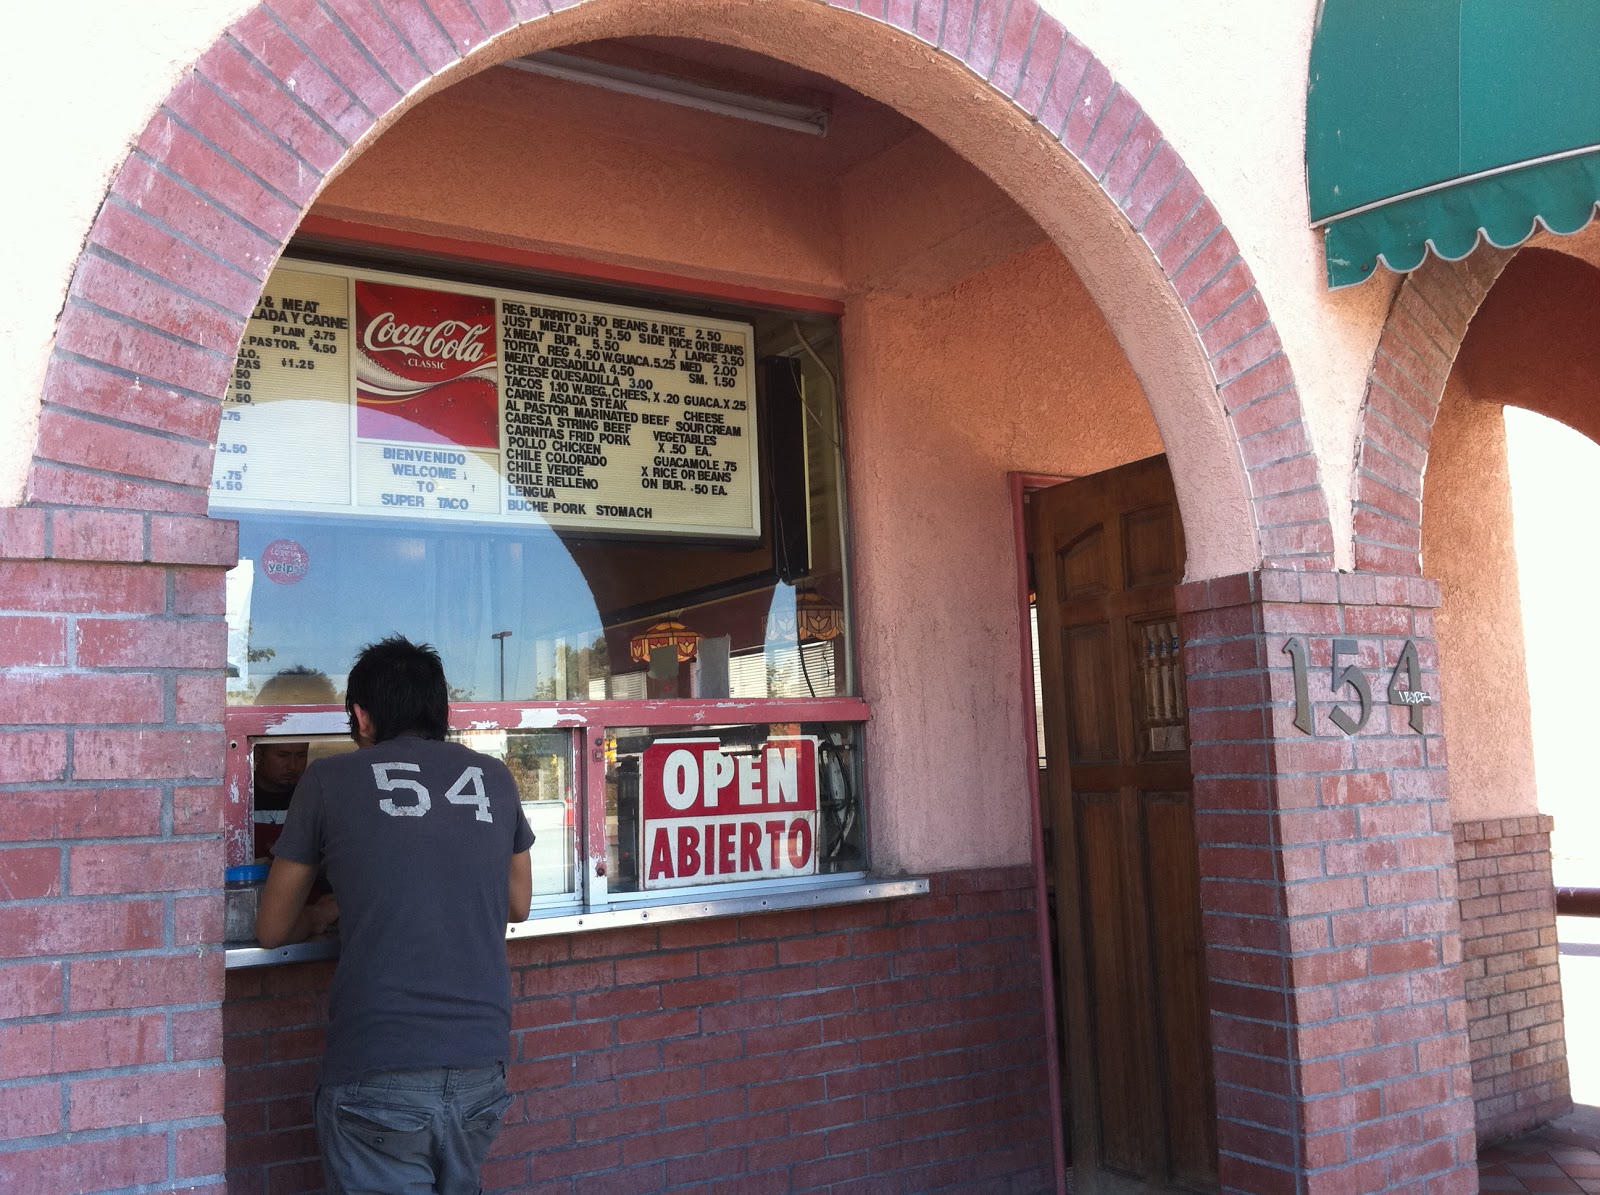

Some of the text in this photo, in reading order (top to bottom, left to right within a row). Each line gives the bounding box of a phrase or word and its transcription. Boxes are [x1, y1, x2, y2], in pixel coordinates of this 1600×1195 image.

[282, 298, 320, 313] MEAT
[291, 312, 300, 324] Y
[303, 314, 348, 330] CARNE
[502, 303, 608, 327] REG. BURRITO 3.50
[273, 326, 336, 340] PLAIN 3.75
[502, 315, 631, 341] JUST MEAT BUR 5.50
[612, 318, 648, 332] BEANS
[651, 323, 658, 334] &
[661, 325, 685, 337] RICE
[249, 336, 300, 350] PASTOR.
[364, 312, 491, 362] Coca-Cola
[554, 334, 580, 347] BUR.
[592, 339, 620, 352] 5.50
[639, 334, 744, 356] SIDE RICE OR BEANS
[503, 339, 540, 354] TORTA
[548, 345, 570, 357] REG
[574, 349, 600, 360] 4.50
[670, 348, 744, 366] X LARGE 3.50
[282, 358, 314, 370] $1.25
[408, 358, 447, 370] CLASSIC
[505, 351, 634, 376] MEAT QUESADILLA 4.50
[680, 361, 738, 376] MED 2.00
[505, 364, 653, 390] CHEESE QUESADILLA 3.00
[689, 374, 736, 388] SM. 1.50
[505, 376, 542, 390] TACOS
[550, 381, 569, 392] 1.10
[654, 392, 660, 402] X
[663, 394, 680, 404] .20
[506, 388, 628, 410] CARNE ASADA STEAK
[506, 400, 670, 426] AL PASTOR MARINATED BEEF
[684, 411, 724, 424] CHEESE
[506, 412, 631, 434] CABESA STRING BEEF
[676, 422, 742, 436] SOUR CREAM
[506, 424, 631, 446] CARNITAS FRID PORK
[653, 431, 716, 446] VEGETABLES
[220, 443, 247, 454] 3.50
[508, 436, 601, 454] POLLO CHICKEN
[658, 443, 712, 456] X .50 EA.
[384, 448, 466, 465] BIENVENIDO
[506, 448, 607, 466] CHILE COLORADO
[654, 456, 738, 472] GUACAMOLE .75
[392, 464, 456, 480] WELCOME
[507, 460, 584, 476] CHILE VERDE
[641, 466, 732, 482] X RICE OR BEANS
[216, 480, 242, 491] 1.50
[417, 480, 434, 493] TO
[508, 473, 598, 490] CHILE RELLENO
[642, 478, 728, 495] ON BUR. .50 EA.
[508, 485, 556, 498] LENGUA
[382, 494, 469, 510] SUPER TACO
[508, 500, 652, 518] BUCHE PORK STOMACH
[268, 561, 294, 574] yelp
[1282, 637, 1431, 735] 154
[662, 747, 799, 810] OPEN
[648, 818, 812, 880] ABIERTO
